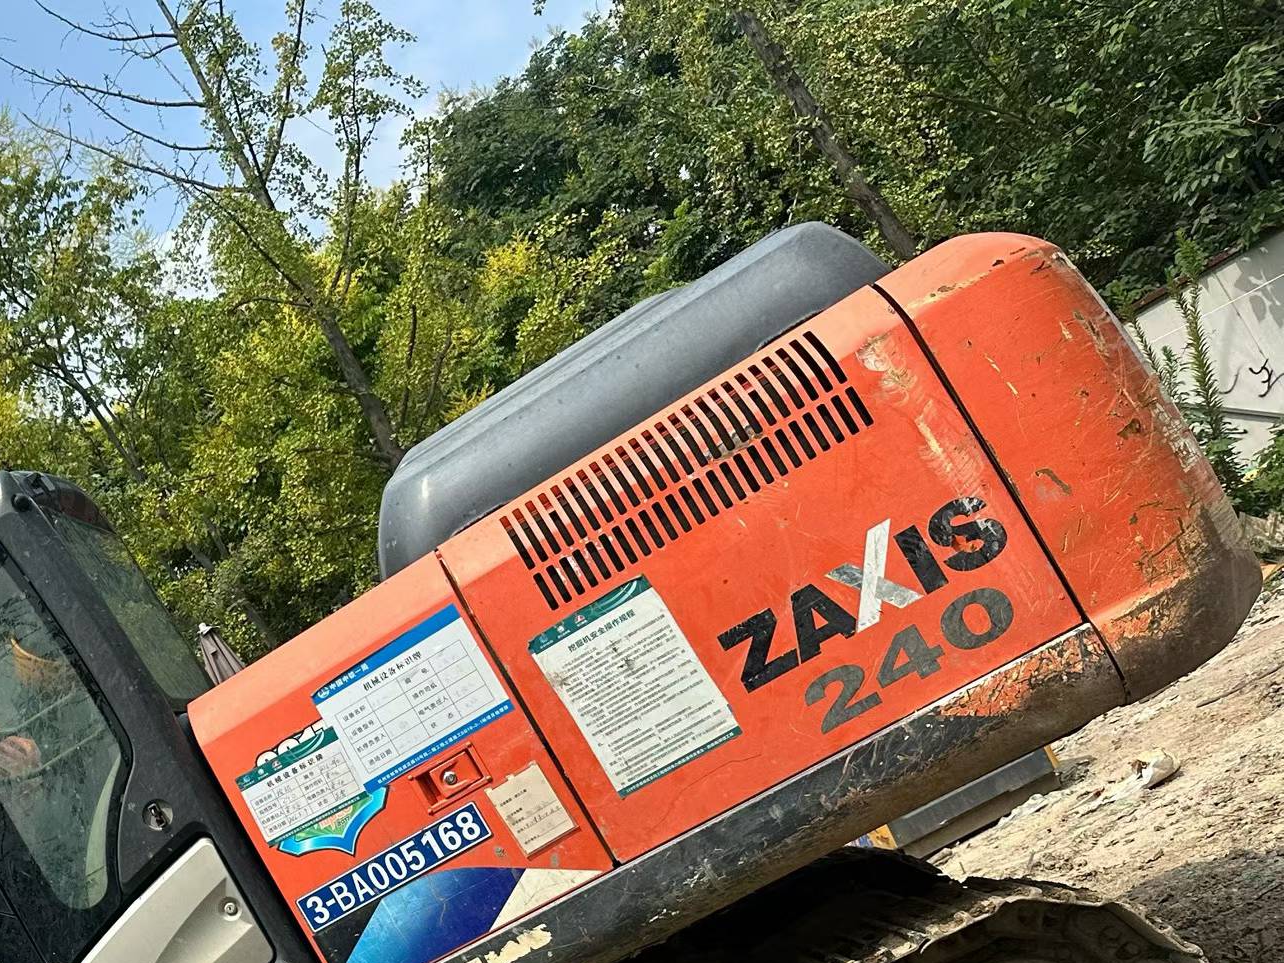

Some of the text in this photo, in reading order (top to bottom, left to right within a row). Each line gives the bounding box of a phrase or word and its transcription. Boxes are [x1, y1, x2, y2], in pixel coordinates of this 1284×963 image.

[717, 497, 1007, 693] ZAXIS
[567, 609, 636, 653] 挖掘机安全操作规程
[330, 664, 369, 690] 中国中铁一局
[362, 651, 423, 692] 机械设备标识牌
[805, 588, 1014, 734] 240
[266, 753, 324, 788] 机械设备标识牌
[306, 811, 481, 924] 3-BA005168
